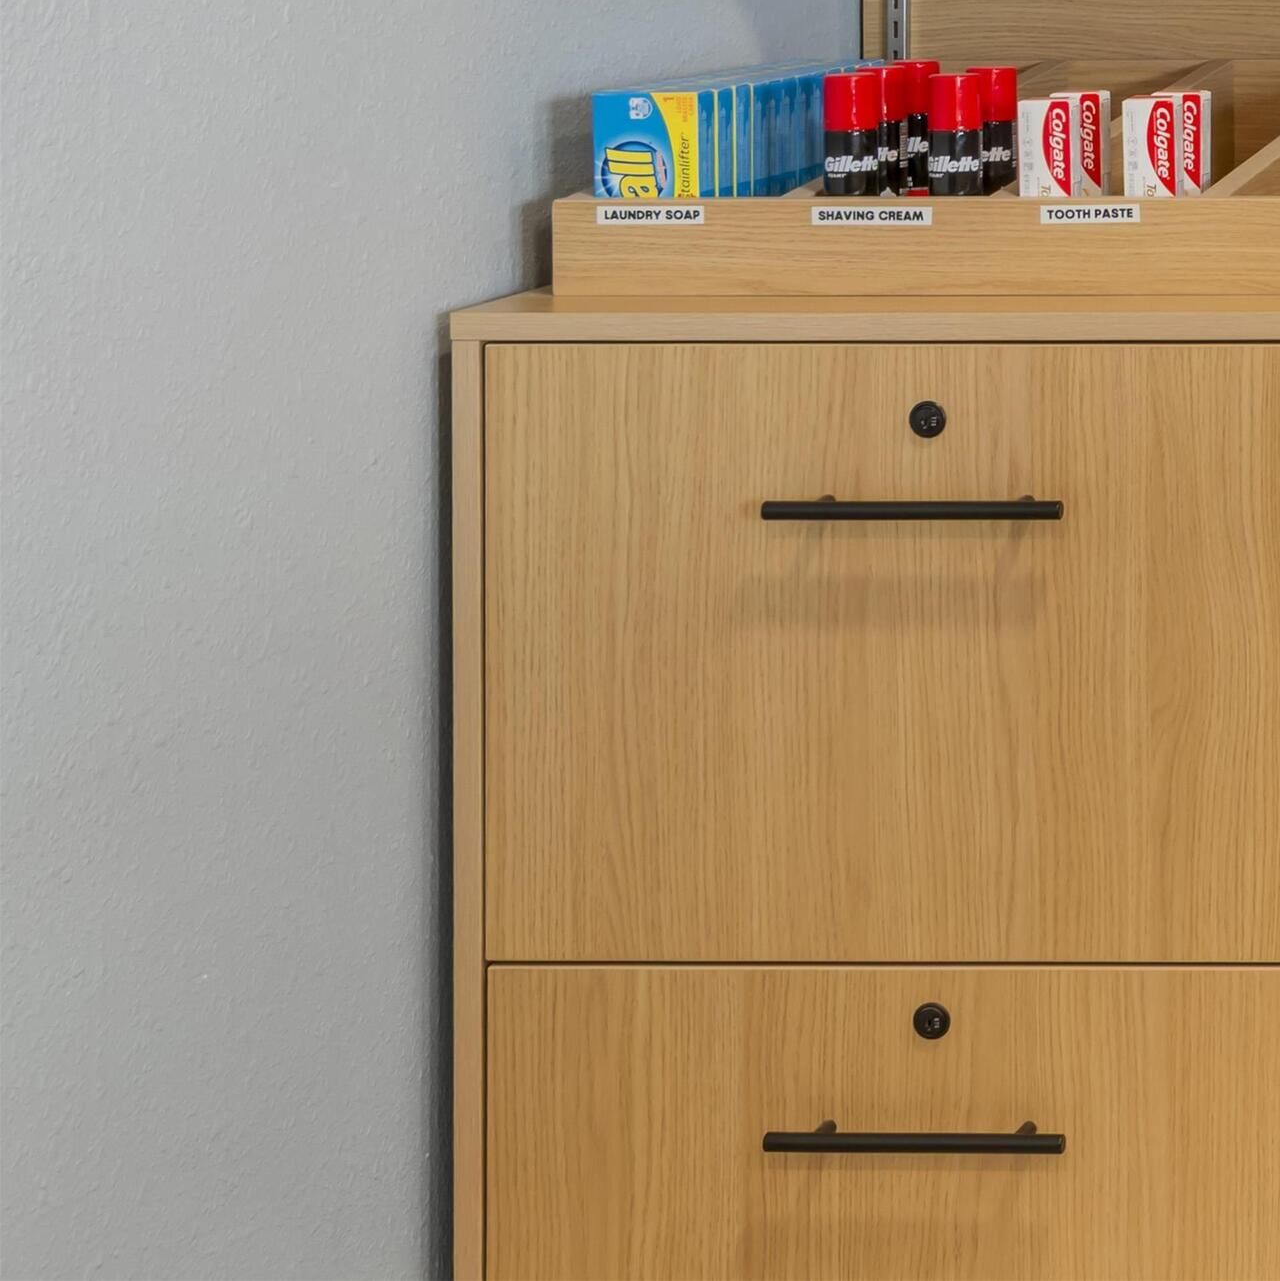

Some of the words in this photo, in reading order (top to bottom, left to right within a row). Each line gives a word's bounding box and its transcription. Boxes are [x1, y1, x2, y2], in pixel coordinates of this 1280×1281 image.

[1052, 108, 1067, 181] Colgate
[1156, 105, 1171, 180] Colgate
[824, 155, 878, 173] Gillette
[604, 210, 662, 220] LAUNDRY
[665, 210, 701, 220] SOAP
[818, 211, 875, 221] SHAVING
[878, 211, 924, 221] CREAM
[1047, 209, 1092, 220] TOOTH
[1095, 208, 1134, 219] PASTE
